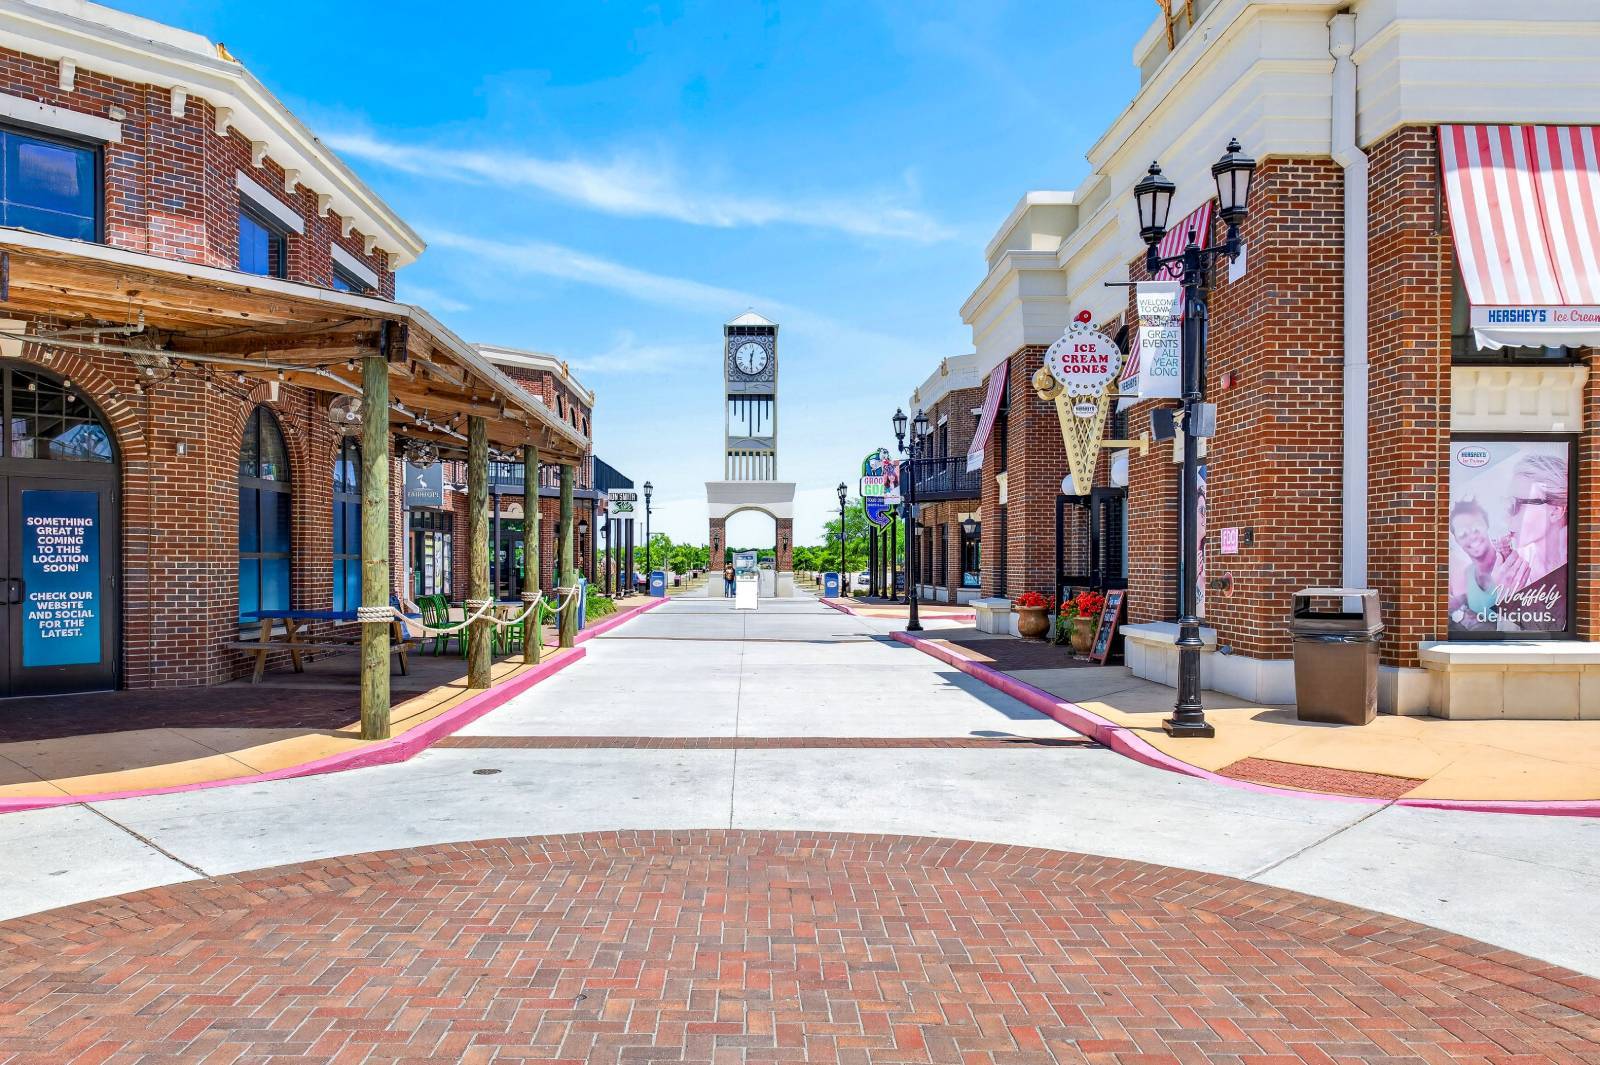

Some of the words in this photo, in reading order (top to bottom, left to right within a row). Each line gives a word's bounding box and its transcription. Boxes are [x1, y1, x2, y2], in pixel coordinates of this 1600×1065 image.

[1488, 310, 1546, 322] HERSHEY'S
[1553, 310, 1568, 321] Ice
[1147, 330, 1178, 338] GREAT
[1074, 344, 1096, 352] ICE
[1142, 339, 1178, 348] EVENTS
[1161, 349, 1179, 357] ALL
[1061, 354, 1109, 364] CREAM
[1153, 358, 1178, 367] YEAR
[1063, 364, 1108, 374] CONES
[1149, 368, 1178, 377] LONG
[26, 517, 93, 526] SOMETHING
[36, 526, 72, 535] GREAT
[74, 527, 85, 536] IS
[37, 536, 84, 545] COMING
[37, 545, 54, 554] TO
[56, 545, 81, 554] THIS
[32, 554, 89, 563] LOCATION
[43, 563, 79, 572] SOON!
[29, 592, 67, 601] CHECK
[69, 591, 93, 600] OUR
[1491, 583, 1561, 609] Wafflely
[37, 601, 84, 610] WEBSITE
[28, 611, 52, 620] AND
[55, 609, 95, 619] SOCIAL
[1476, 607, 1556, 623] delicious.
[39, 620, 61, 629] FOR
[63, 618, 85, 628] THE
[41, 628, 82, 638] LATEST.
